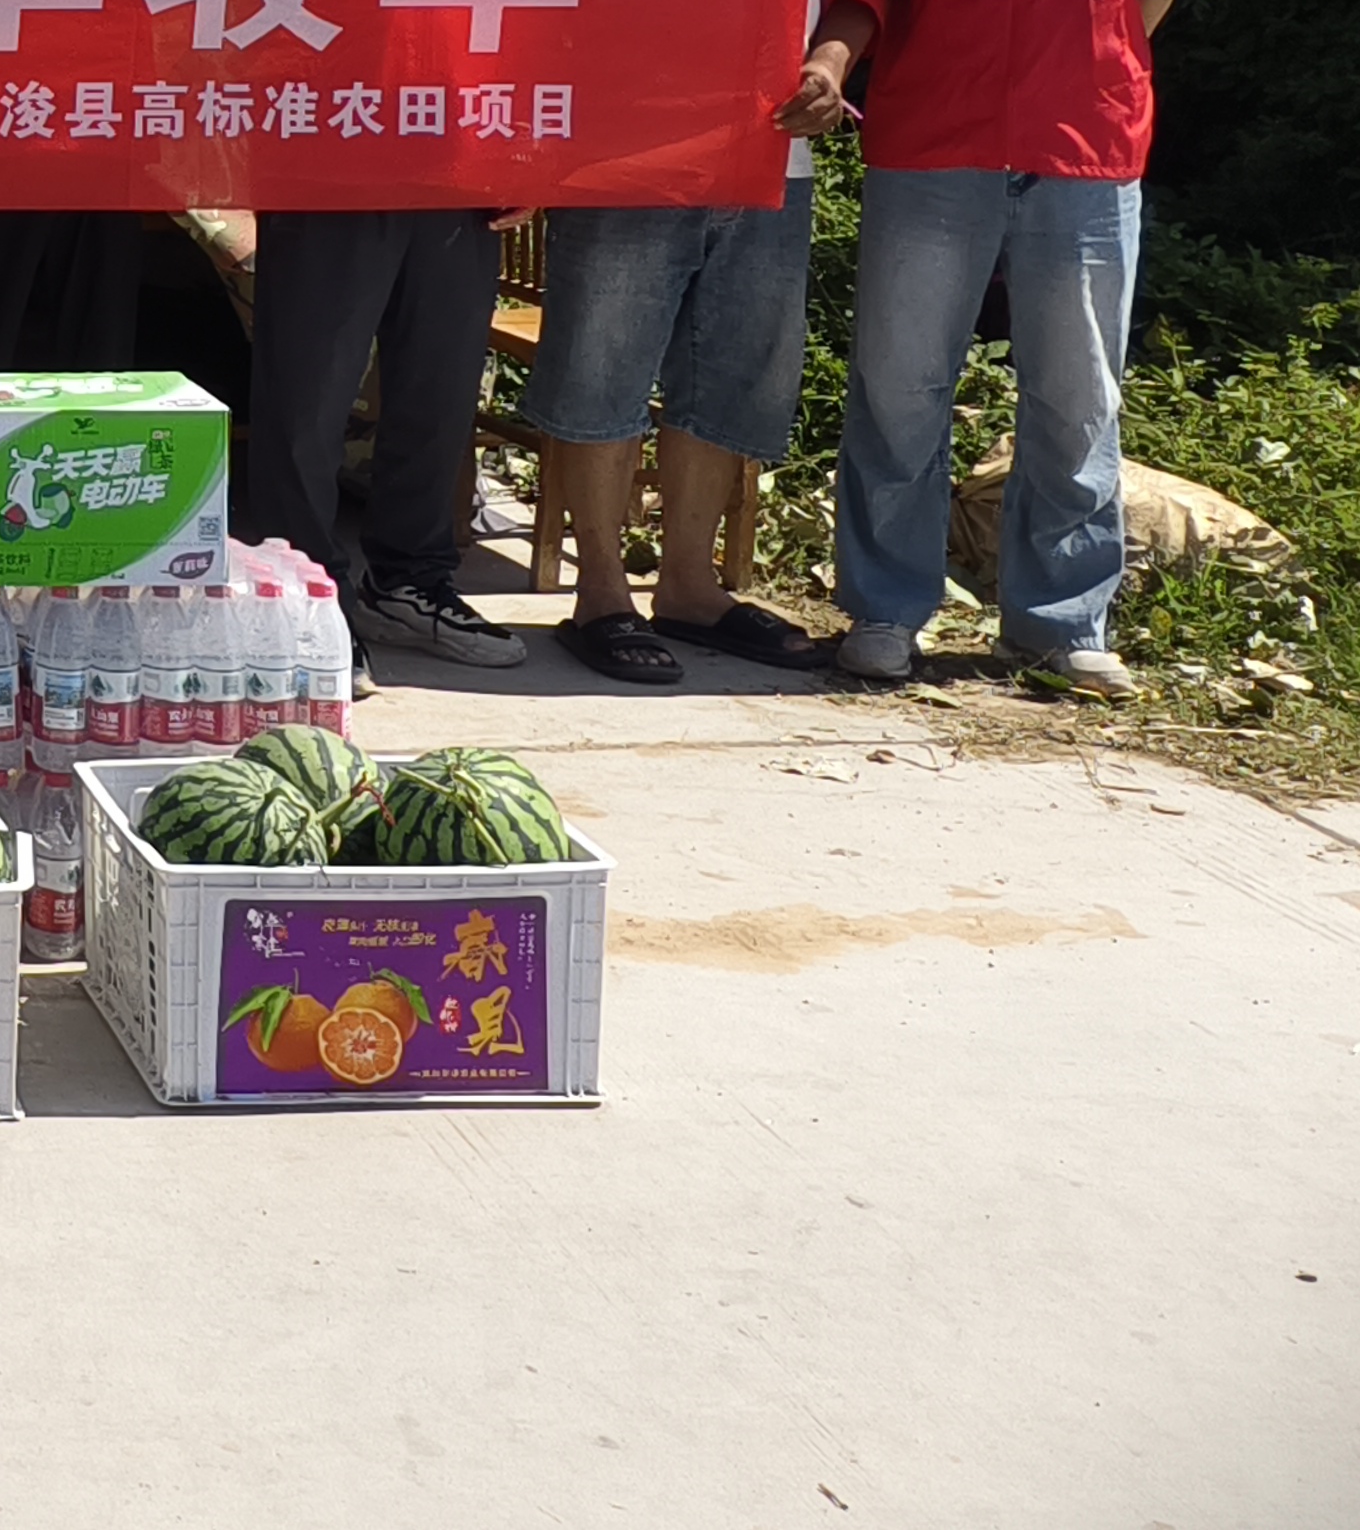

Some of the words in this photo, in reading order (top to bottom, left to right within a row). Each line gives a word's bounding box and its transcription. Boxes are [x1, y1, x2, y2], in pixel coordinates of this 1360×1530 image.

[52, 443, 147, 481] 天天赢
[80, 473, 169, 511] 电动车
